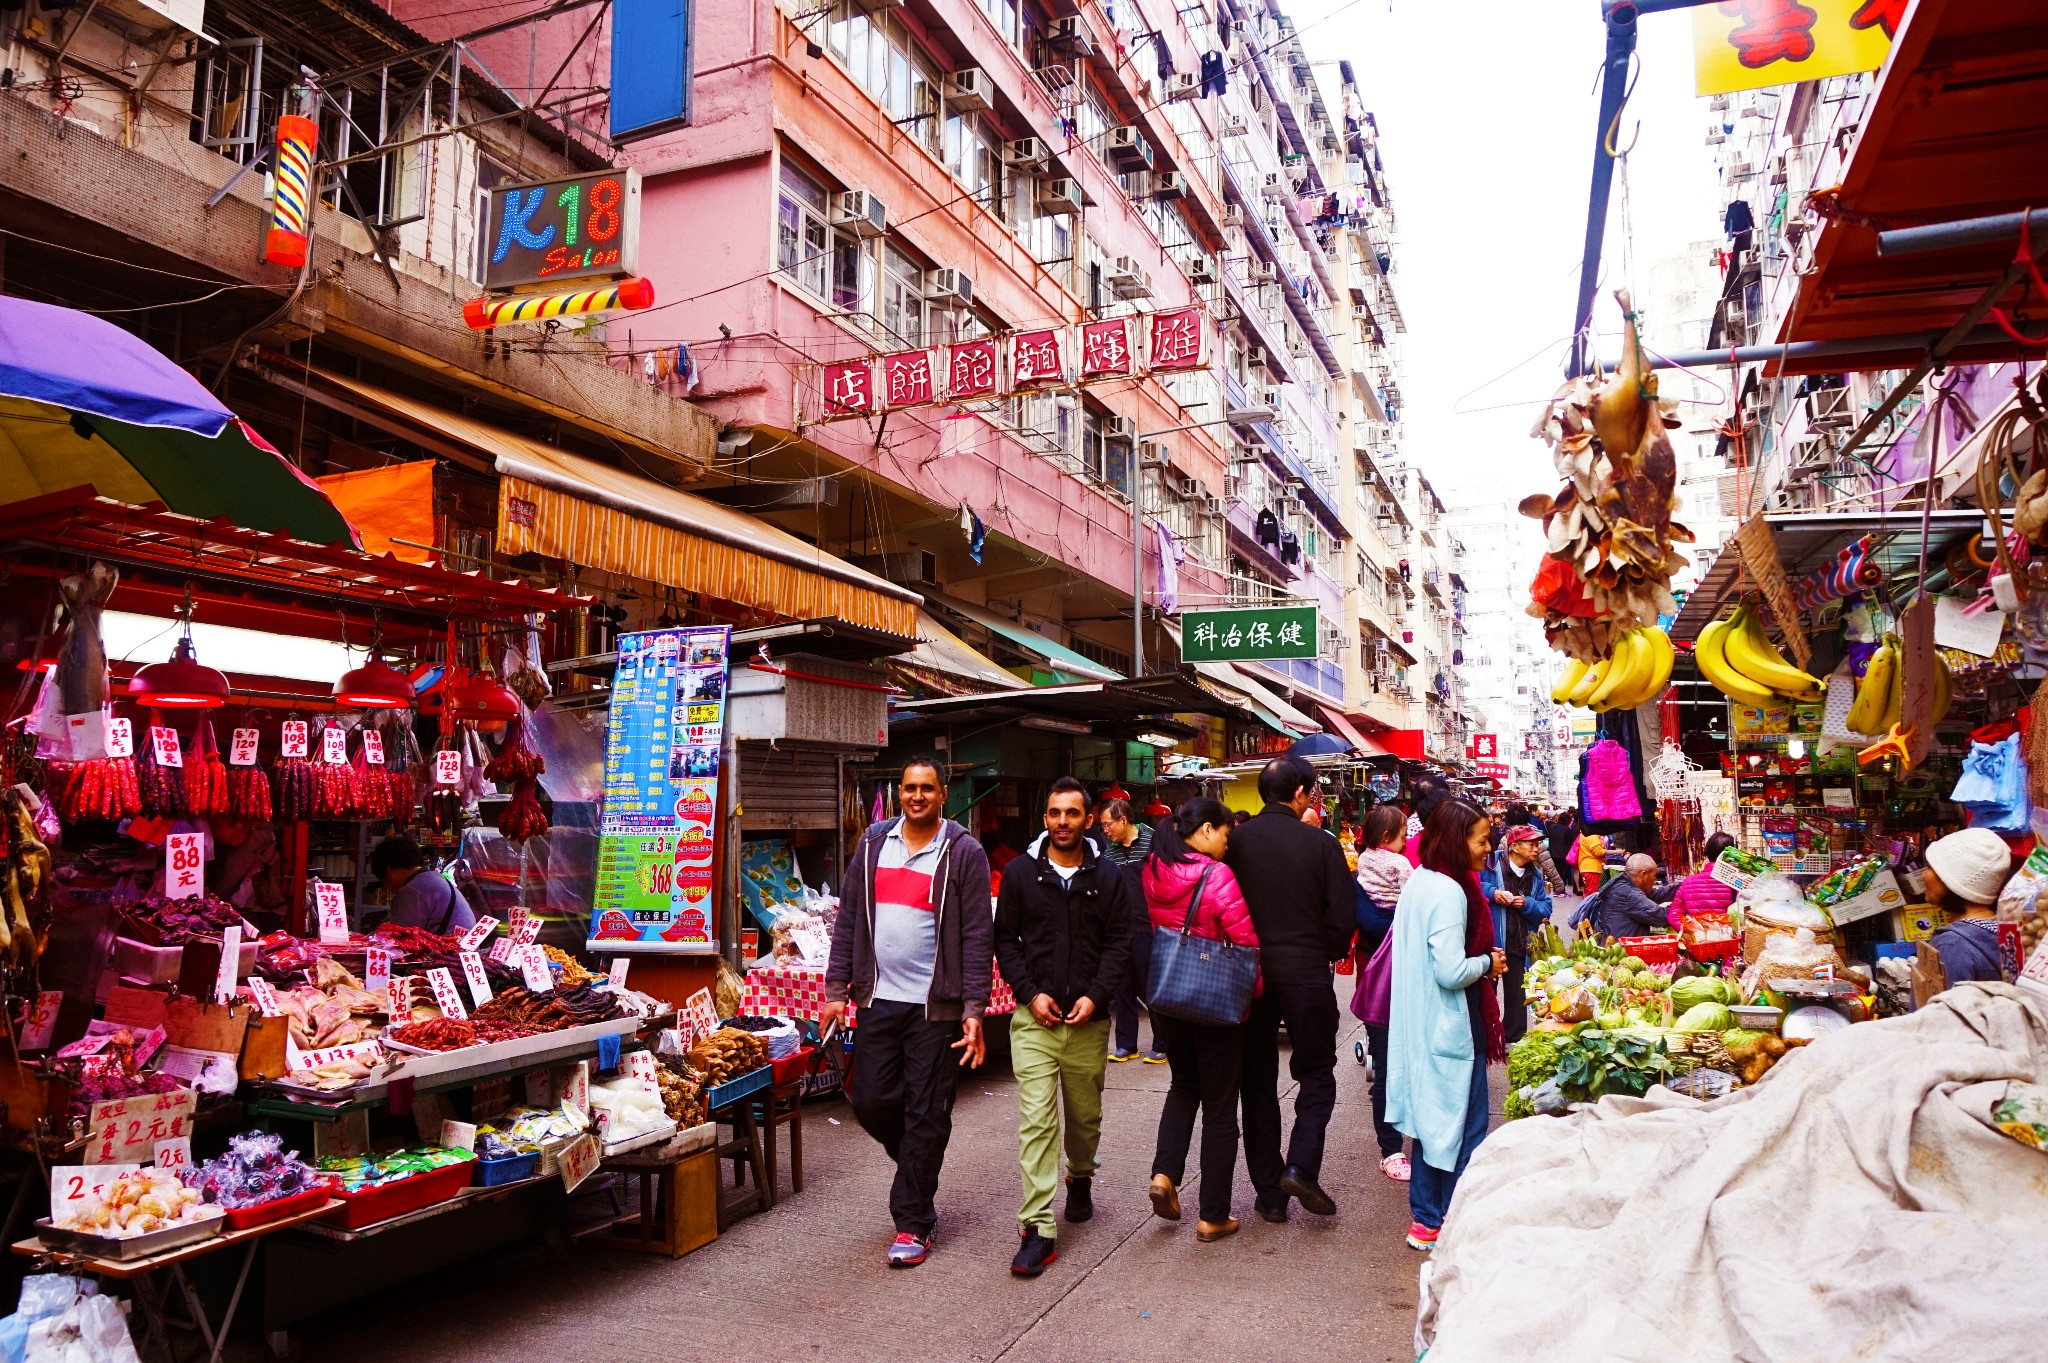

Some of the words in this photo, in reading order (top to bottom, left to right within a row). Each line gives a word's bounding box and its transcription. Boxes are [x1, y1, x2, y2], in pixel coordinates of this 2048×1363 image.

[492, 178, 622, 265] K18
[539, 246, 619, 278] Salon
[111, 728, 129, 739] 52
[284, 733, 306, 745] 108
[111, 739, 124, 747] 元
[157, 740, 178, 752] 120
[235, 739, 255, 749] 120
[327, 739, 345, 751] 108
[367, 742, 382, 751] 108
[288, 744, 303, 755] 元
[331, 751, 341, 760] 元
[164, 753, 178, 765] 元
[237, 752, 250, 761] 元
[371, 752, 383, 762] 元
[439, 761, 459, 772] 128
[443, 772, 455, 780] 元
[683, 829, 704, 843] $168
[172, 846, 200, 871] 88
[178, 871, 197, 888] 元
[642, 863, 673, 896] $368
[320, 895, 338, 908] 35
[327, 907, 341, 917] 元
[471, 926, 488, 937] 80
[516, 929, 535, 945] 80
[523, 955, 541, 968] 90
[431, 971, 445, 982] 15
[466, 963, 481, 978] 90
[388, 987, 407, 1004] 96
[447, 1006, 460, 1017] 60
[680, 1029, 691, 1044] 28
